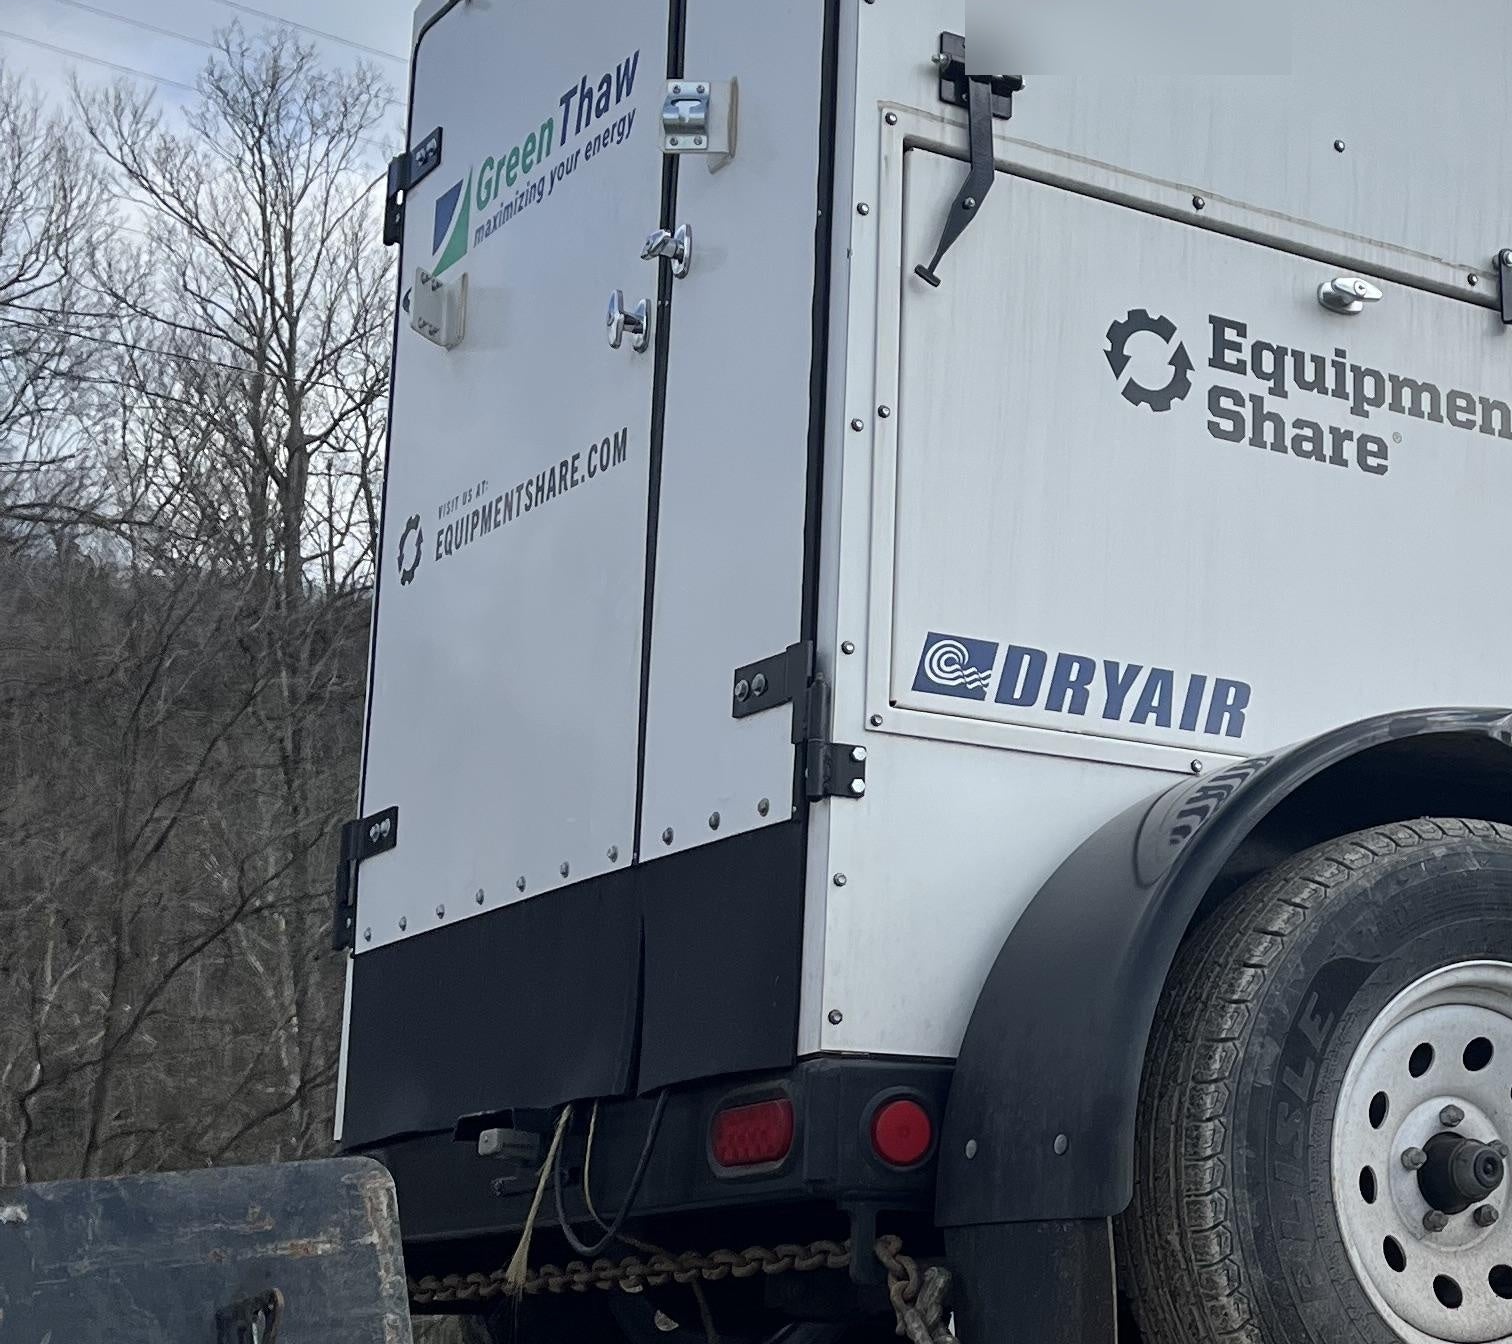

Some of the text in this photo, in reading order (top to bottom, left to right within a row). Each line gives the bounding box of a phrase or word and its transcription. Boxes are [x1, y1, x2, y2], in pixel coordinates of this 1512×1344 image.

[473, 108, 637, 249] maximizing your energy
[434, 426, 628, 562] EQUIPMENTSHARE.COM
[438, 494, 460, 521] VISIT
[462, 487, 473, 506] US
[994, 644, 1252, 739] DRYAIR
